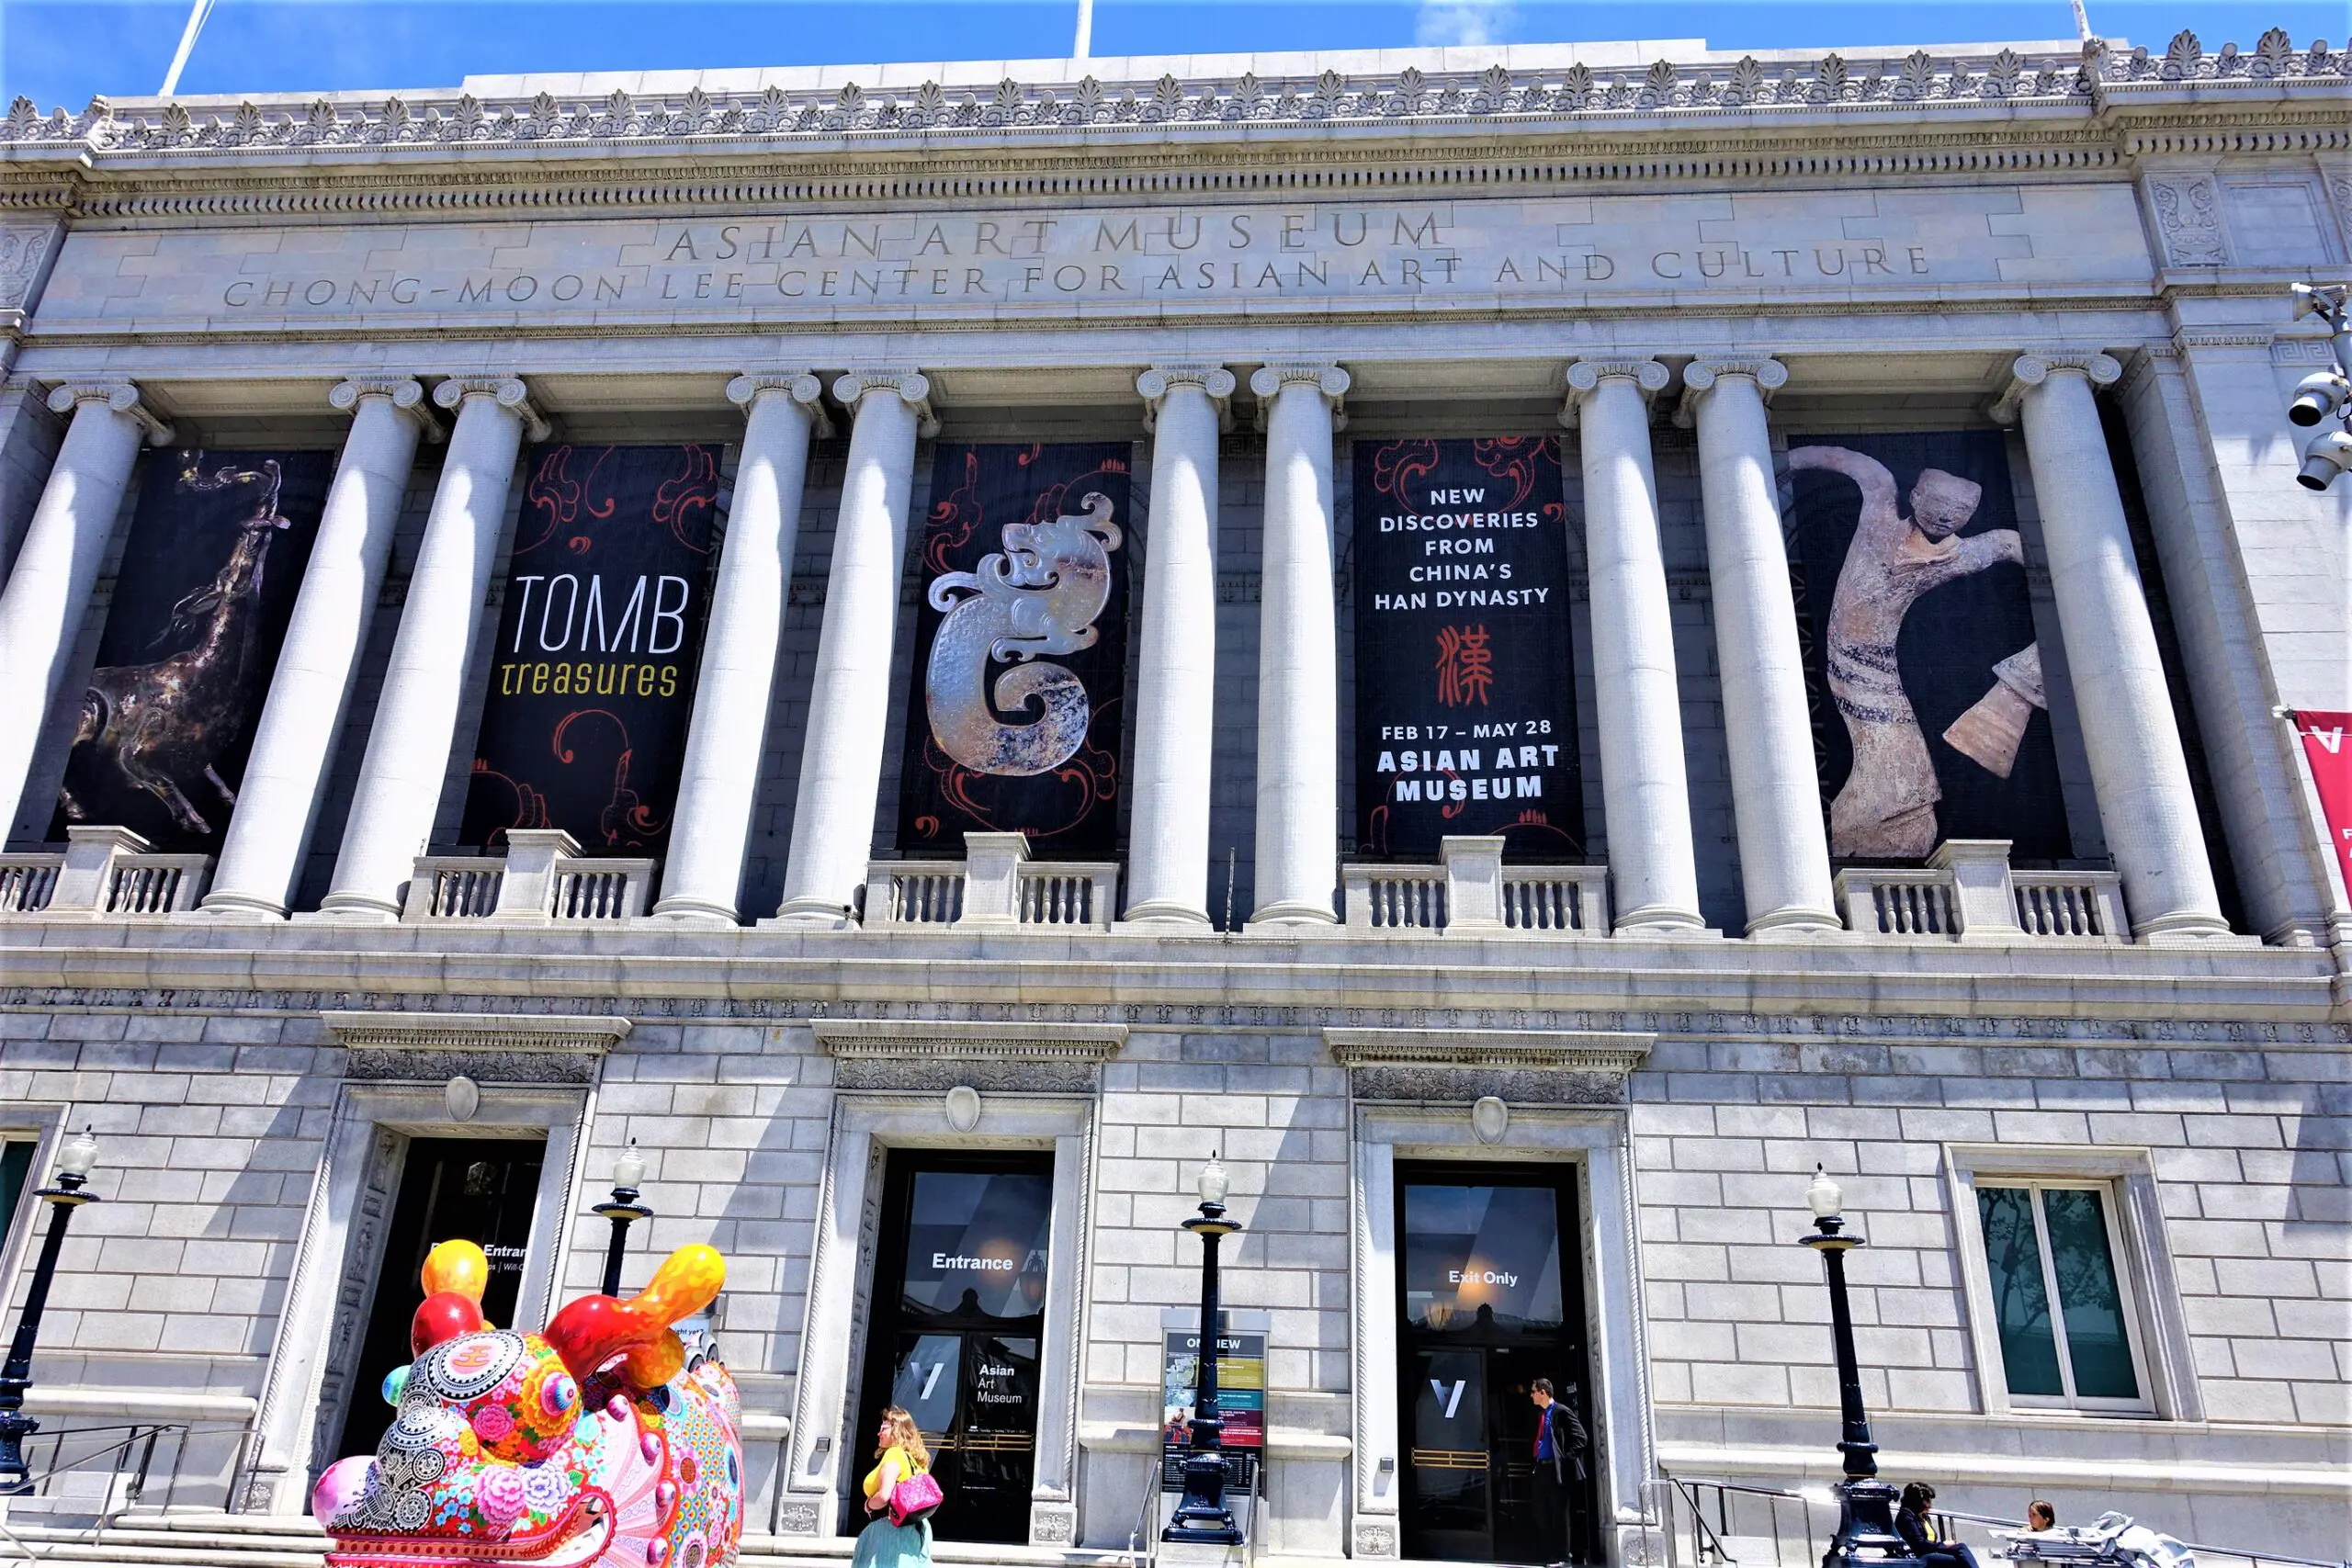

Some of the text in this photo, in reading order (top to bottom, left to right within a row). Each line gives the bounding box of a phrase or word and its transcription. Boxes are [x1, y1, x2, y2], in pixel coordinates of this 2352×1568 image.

[664, 210, 1446, 261] ASIAN ART MUSEUM
[223, 247, 1930, 307] CHONG-MOON LEE CENTER FOR ASIAN ART AND CULTURE
[1430, 489, 1485, 505] NEW
[1380, 513, 1538, 532] DISCOVERIES
[1425, 538, 1494, 556] FROM
[1409, 563, 1511, 581] CHINA'S
[1374, 588, 1549, 610] HAN DYNASTY
[514, 574, 689, 653] TOMB
[502, 662, 677, 697] treasures
[1382, 726, 1419, 740] FEB
[1426, 726, 1449, 739] 17
[1473, 723, 1518, 738] MAY
[1525, 720, 1552, 736] 28
[1377, 745, 1559, 773] ASIAN ART
[1396, 775, 1542, 802] MUSEUM
[932, 1252, 1013, 1270] Entrance
[1449, 1269, 1518, 1287] Exit Only
[1216, 1338, 1241, 1349] IEW
[978, 1364, 1014, 1376] Asian
[978, 1377, 995, 1389] Art
[977, 1391, 1023, 1404] Museum
